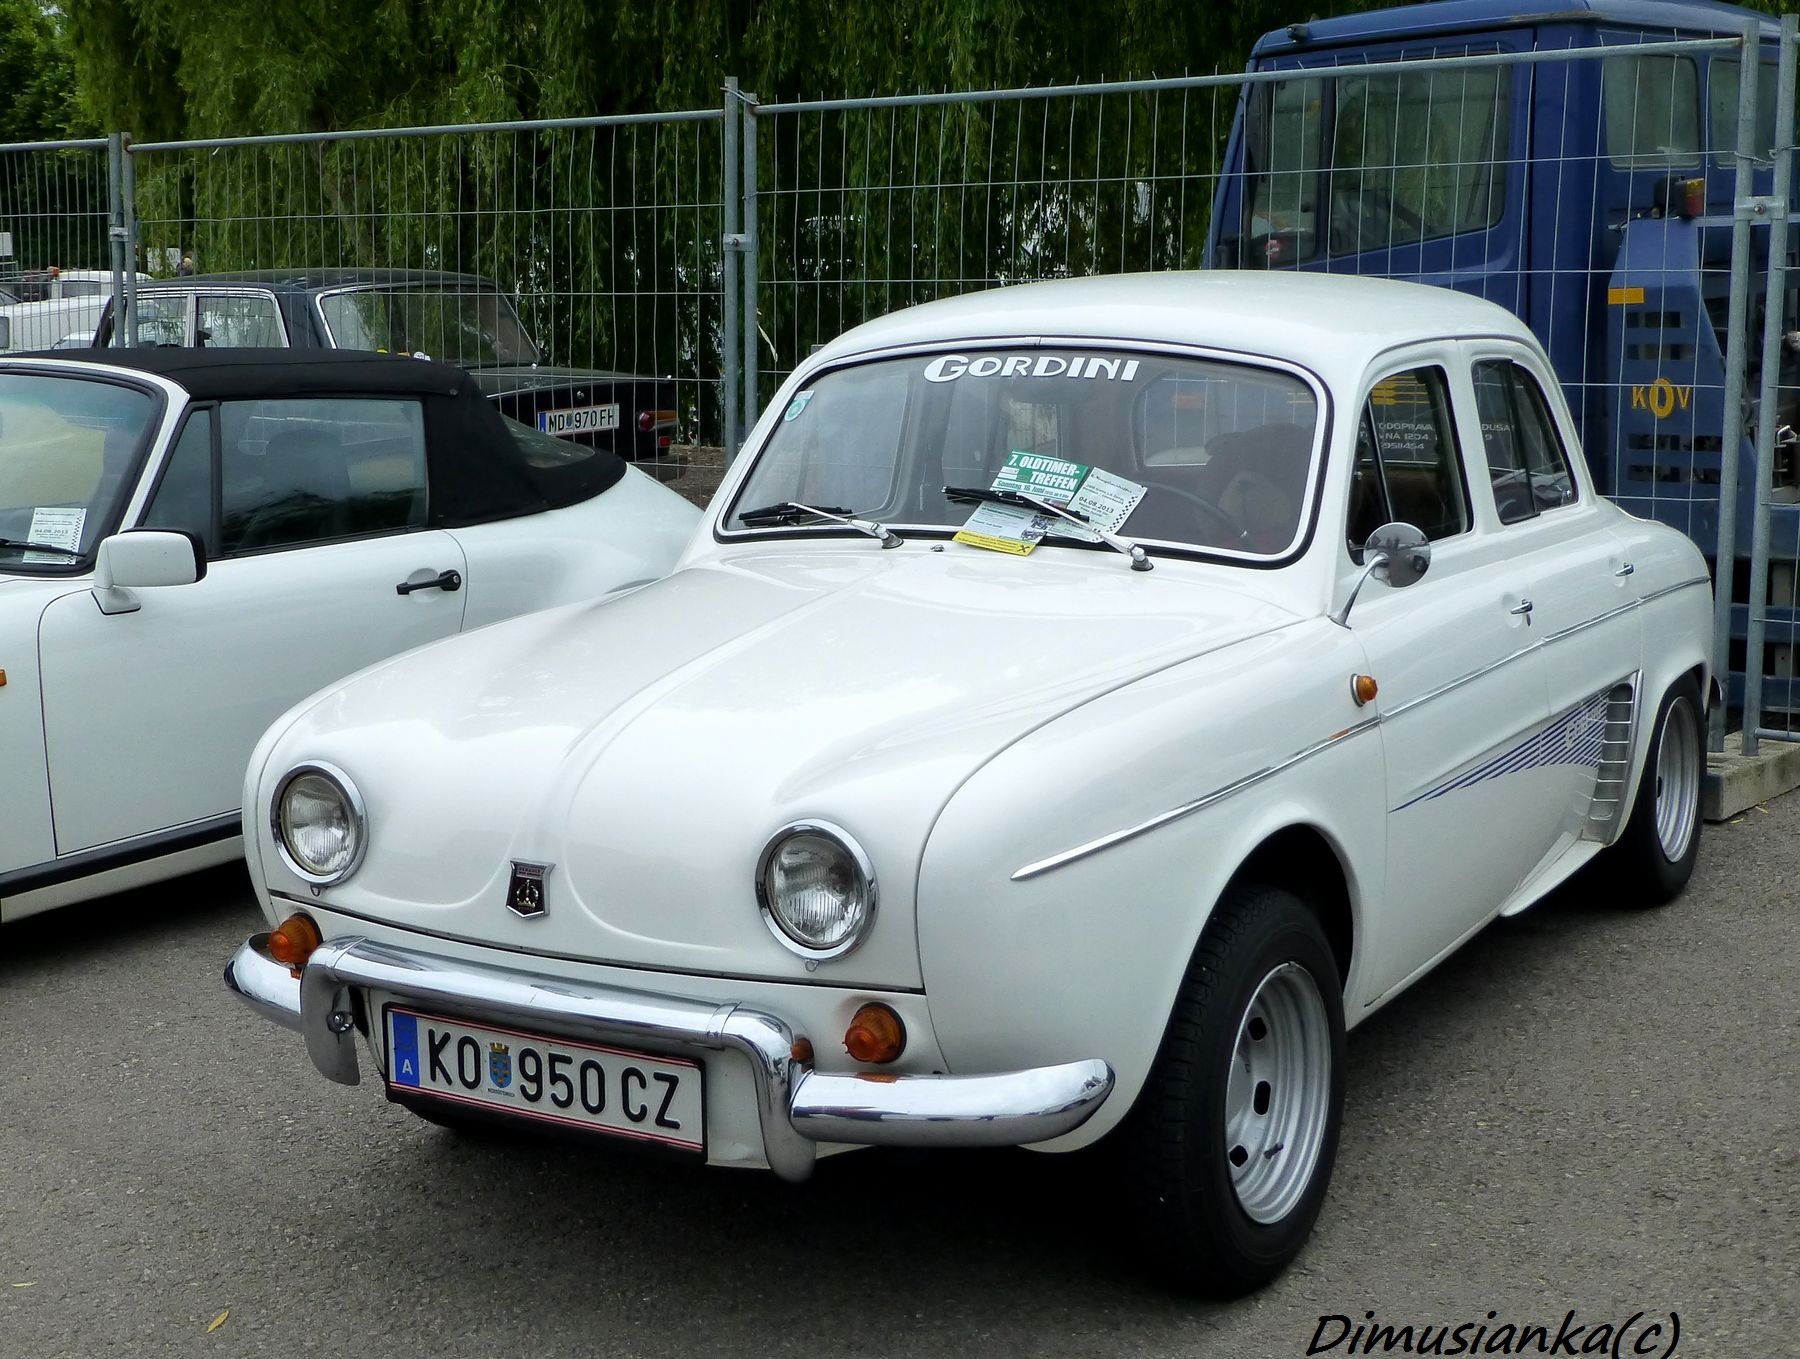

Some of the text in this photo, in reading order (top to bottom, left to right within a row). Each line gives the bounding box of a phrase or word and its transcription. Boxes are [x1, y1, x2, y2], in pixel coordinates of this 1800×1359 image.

[923, 355, 1140, 382] GORDINI
[548, 414, 565, 432] MD
[574, 410, 598, 428] 970
[1009, 454, 1018, 466] 7.
[1019, 456, 1080, 476] OLDTIMER-
[1029, 471, 1078, 490] TREFFEN
[402, 1059, 414, 1076] A
[428, 1028, 681, 1130] KO 950 CZ
